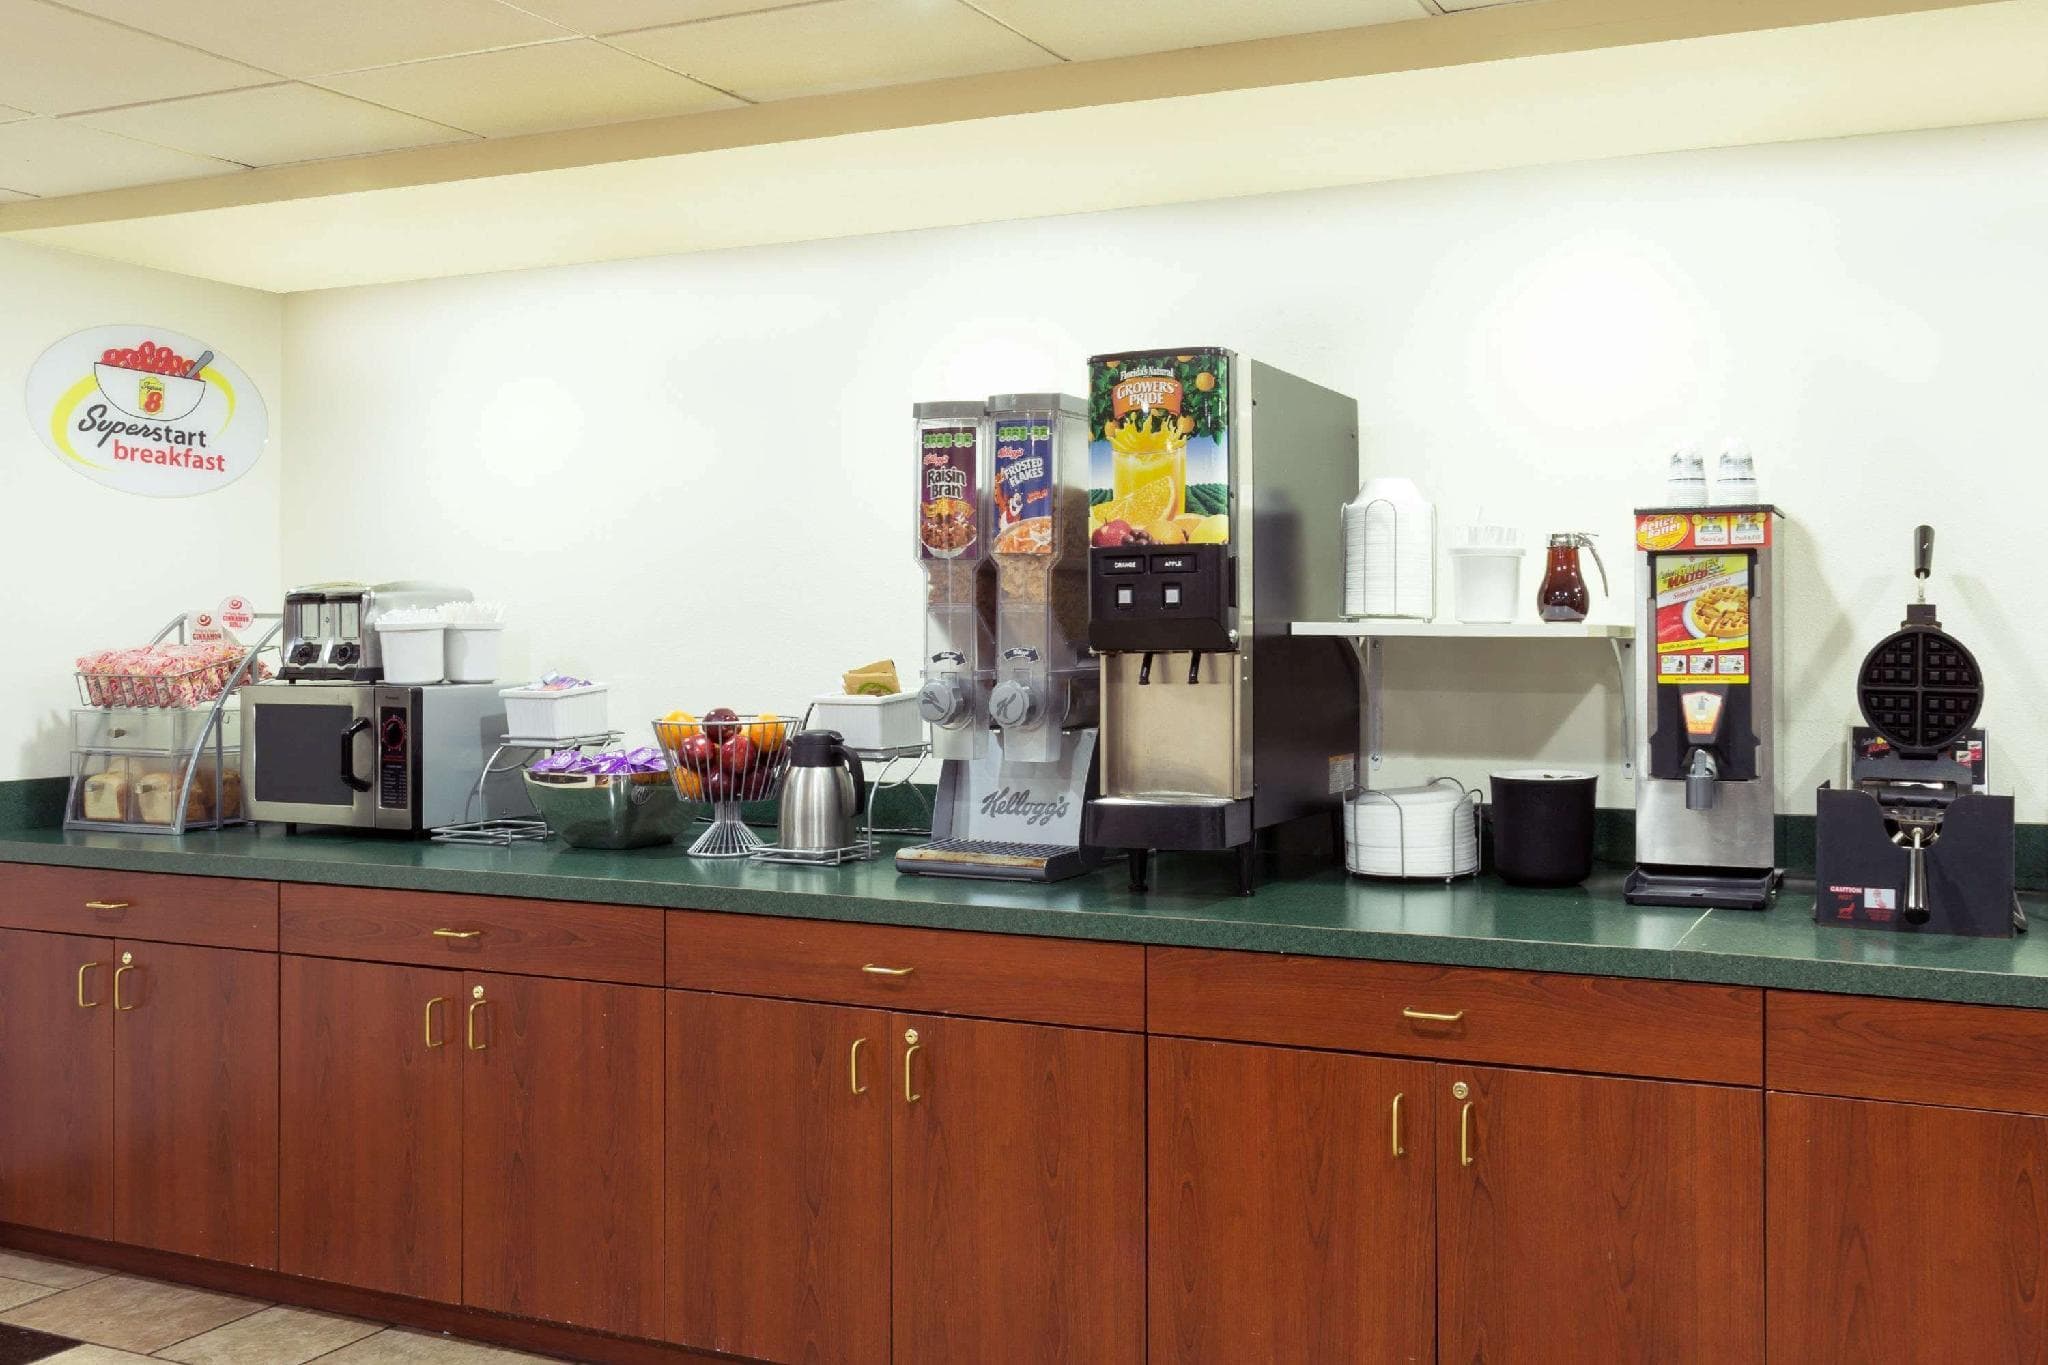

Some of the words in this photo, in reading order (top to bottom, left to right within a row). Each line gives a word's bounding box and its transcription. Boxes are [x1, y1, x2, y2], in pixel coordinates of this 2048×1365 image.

[1120, 366, 1149, 380] Florida's
[1149, 366, 1174, 377] Natural
[1130, 392, 1164, 405] PRIDE
[78, 404, 207, 448] Superstart
[113, 439, 226, 472] breakfast
[927, 466, 967, 487] Raisin
[1003, 456, 1043, 481] FROSTED
[1010, 467, 1044, 488] FLAKES
[931, 484, 963, 499] Bran
[1114, 561, 1136, 569] ORANGE
[980, 786, 1070, 826] Kellogg's
[1830, 886, 1862, 894] CAUTION
